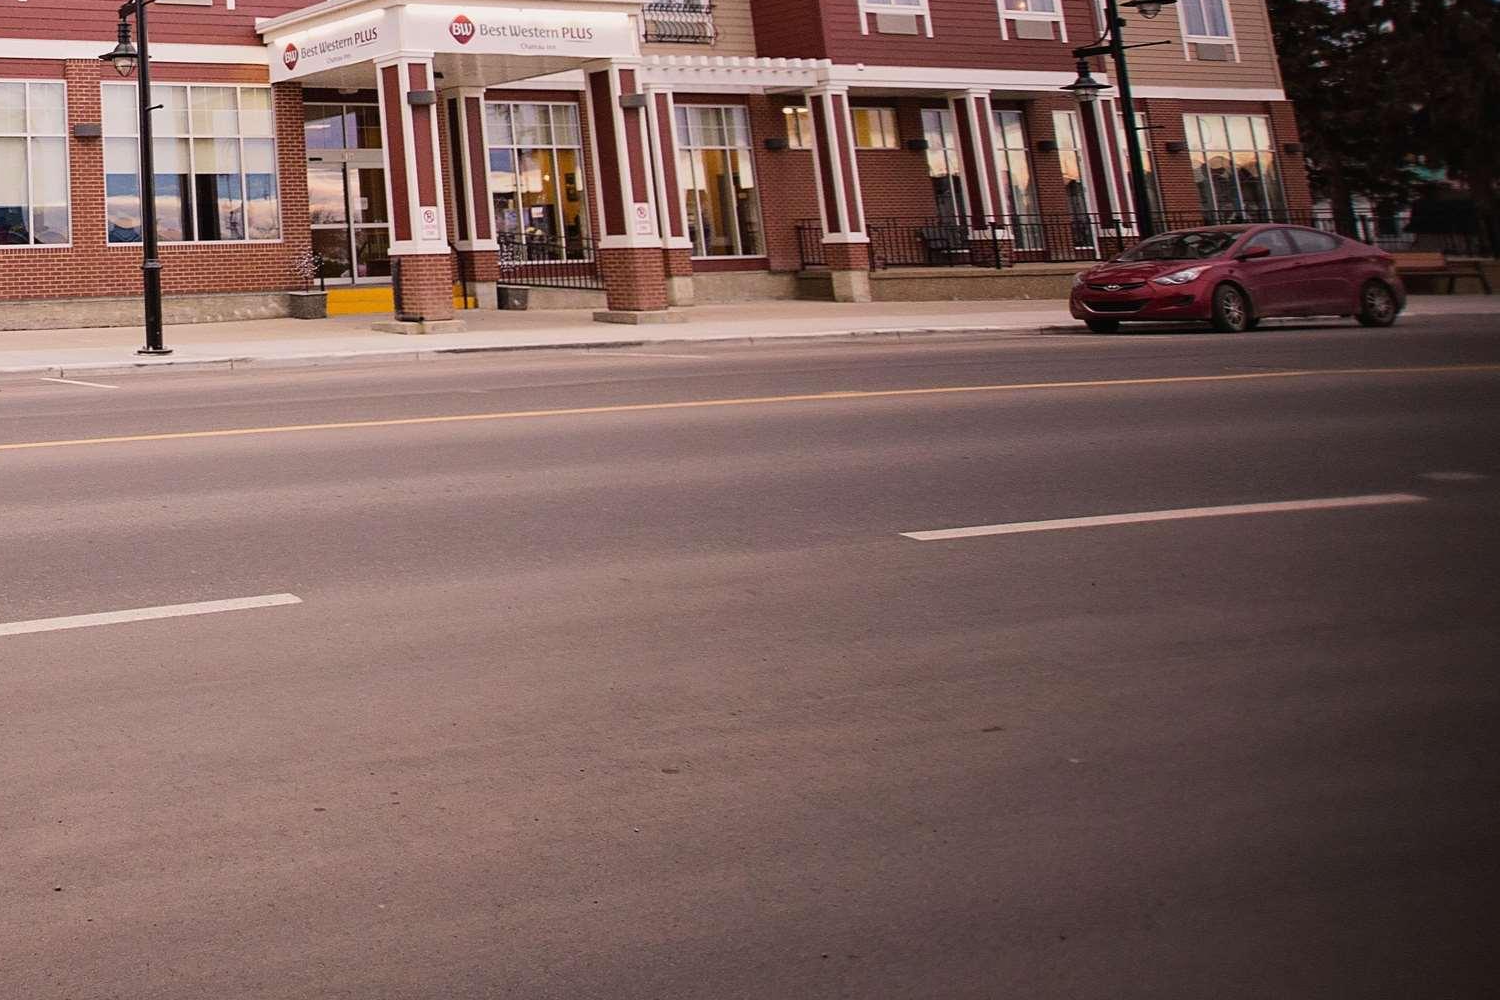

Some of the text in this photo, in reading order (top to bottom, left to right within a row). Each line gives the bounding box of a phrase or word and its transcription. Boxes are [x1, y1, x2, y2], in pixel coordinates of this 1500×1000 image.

[452, 22, 473, 36] BW
[480, 24, 593, 40] Best Western PLUS
[301, 45, 318, 59] Best
[319, 36, 353, 55] Western
[355, 27, 378, 45] PLUS
